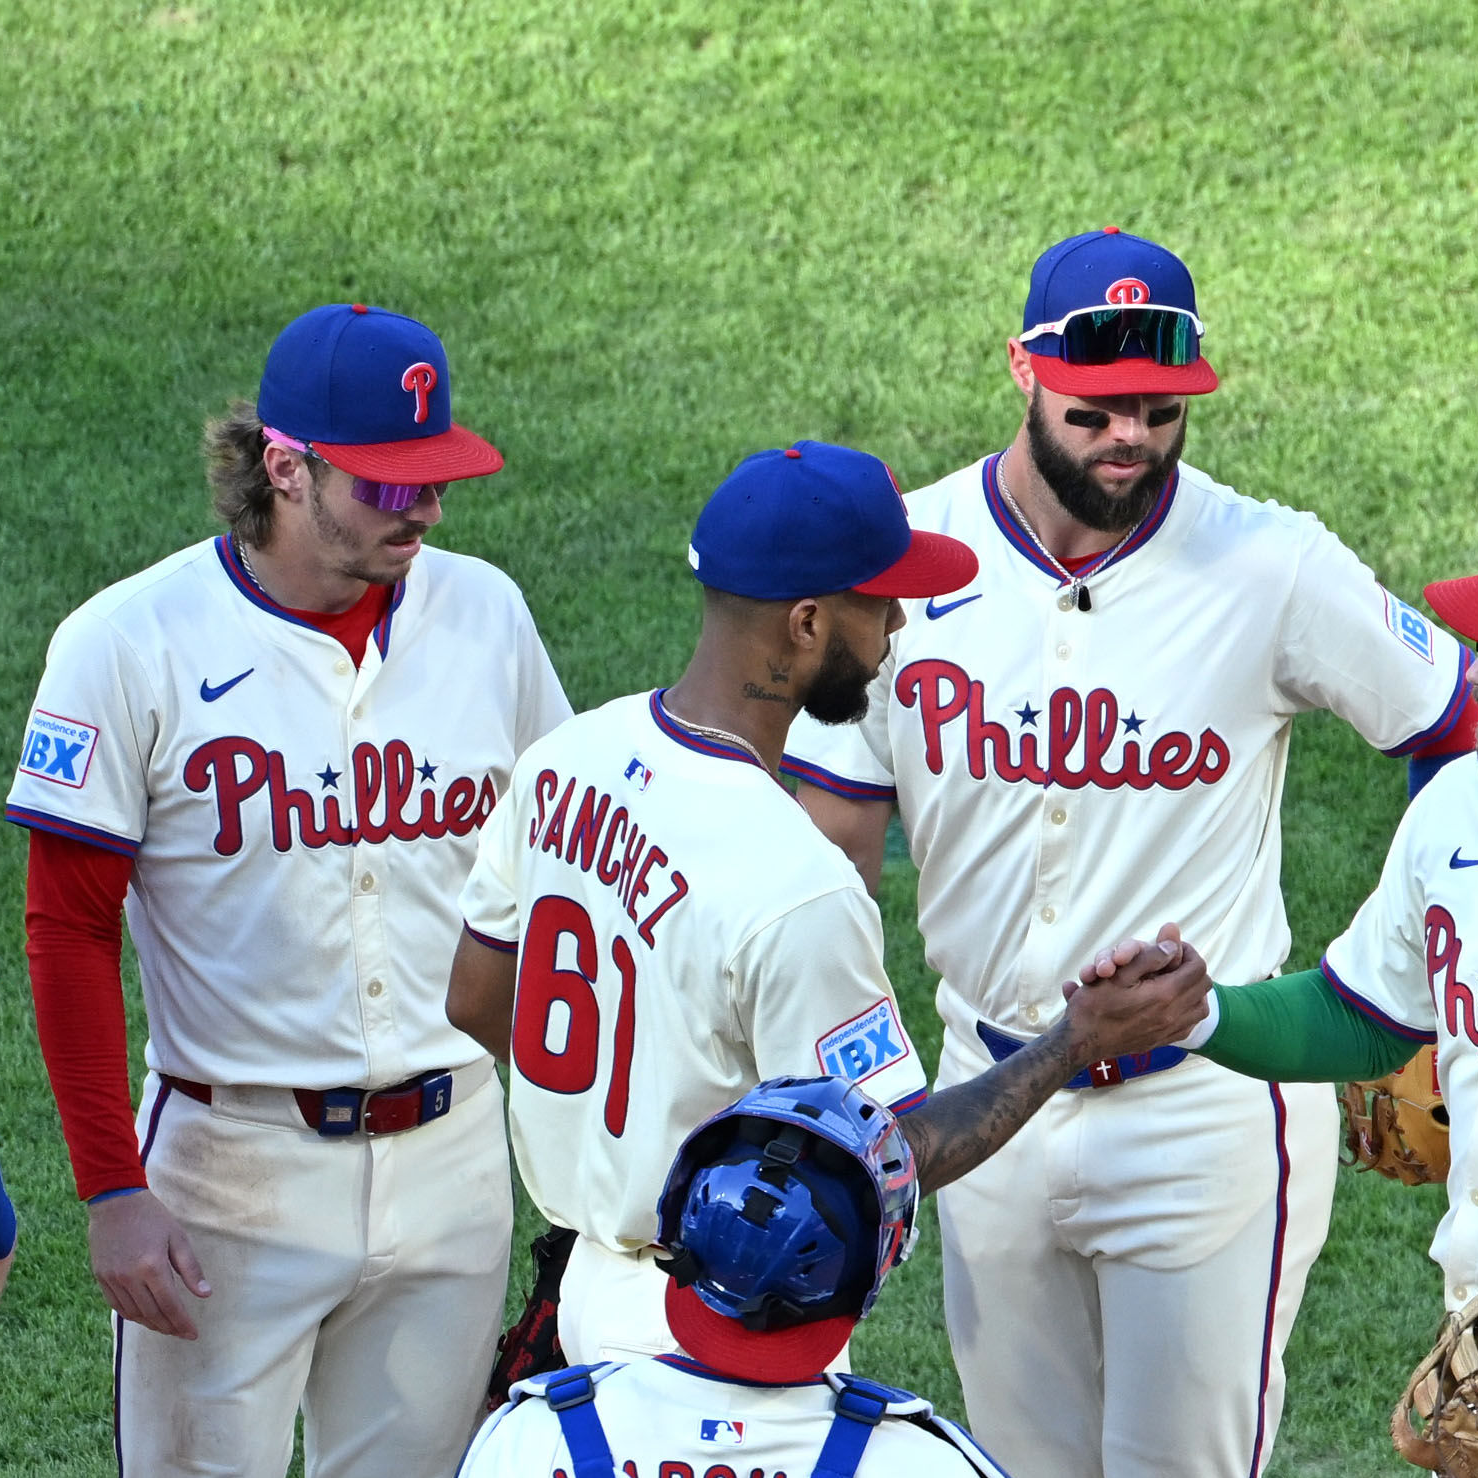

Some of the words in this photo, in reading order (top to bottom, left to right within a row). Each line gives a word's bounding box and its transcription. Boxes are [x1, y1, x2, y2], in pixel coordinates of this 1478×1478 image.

[401, 361, 438, 425] P
[1398, 601, 1430, 659] IB
[21, 730, 85, 781] IBX
[894, 658, 1231, 791] Phillies
[529, 768, 689, 950] SANCHEZ
[512, 894, 637, 1139] 61
[825, 1018, 902, 1081] IBX
[434, 1089, 445, 1112] 5
